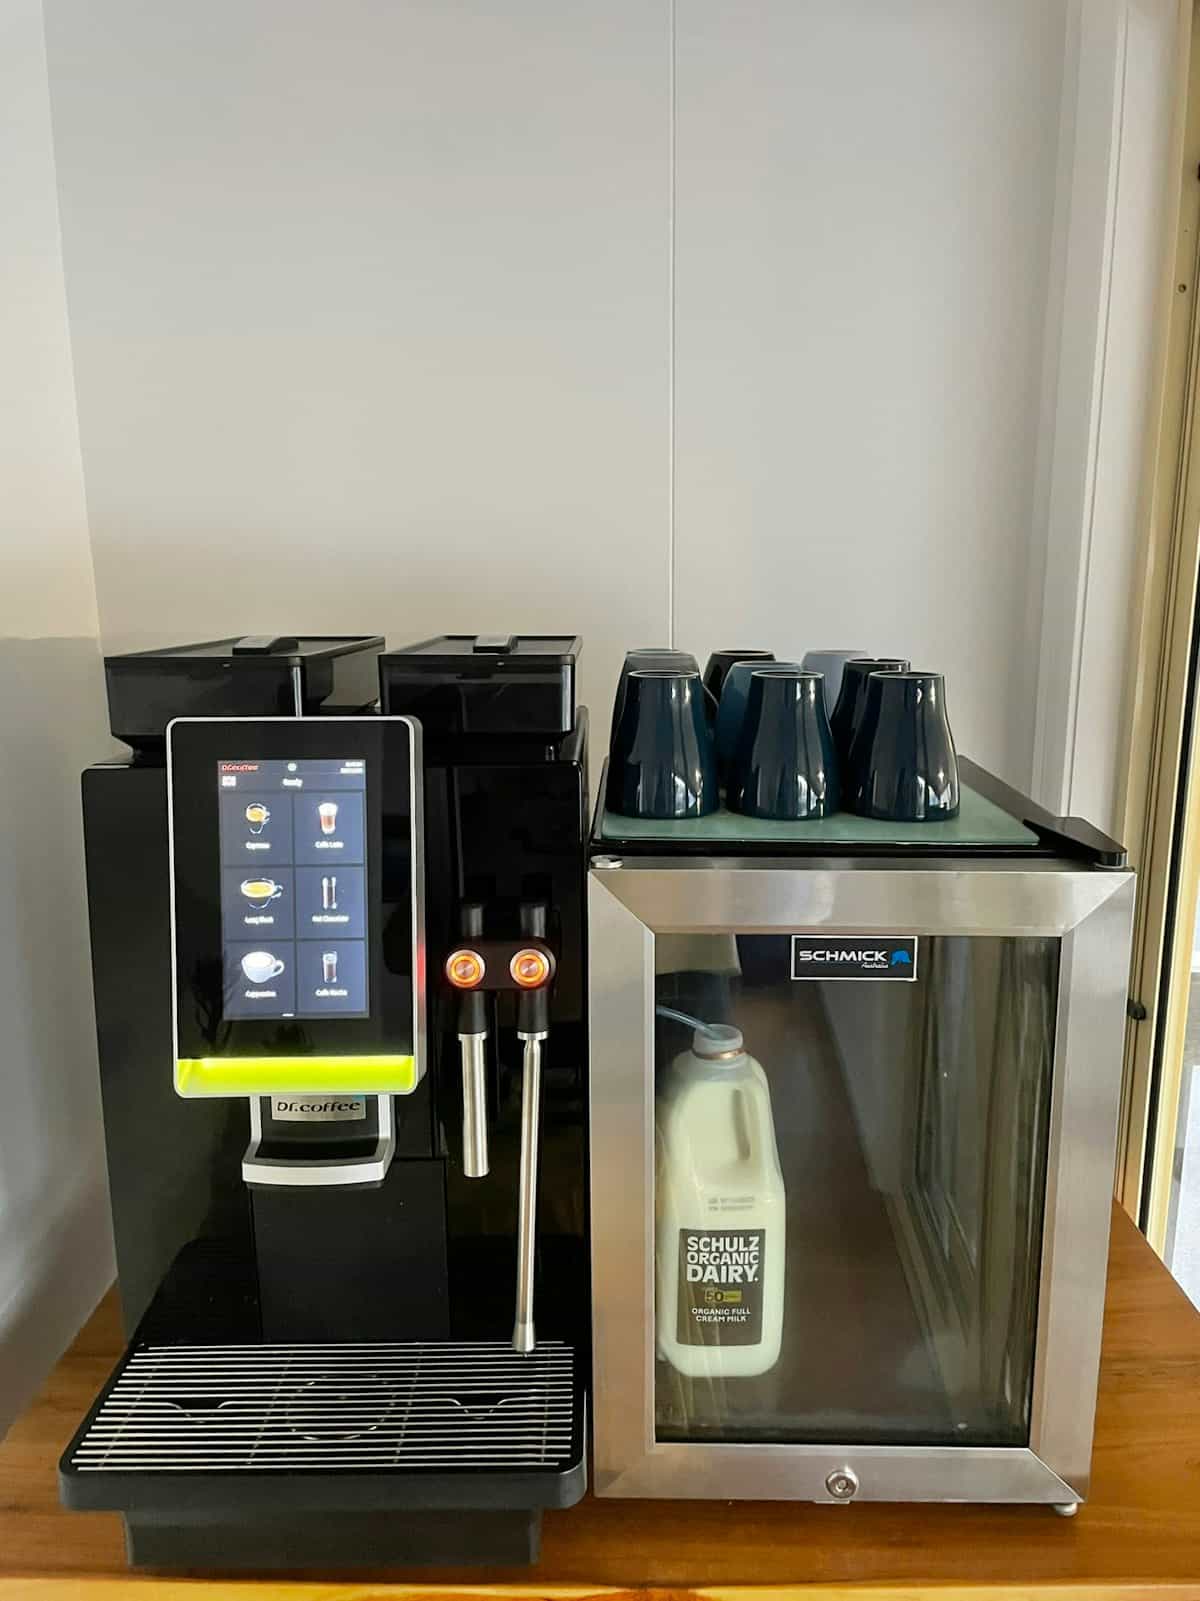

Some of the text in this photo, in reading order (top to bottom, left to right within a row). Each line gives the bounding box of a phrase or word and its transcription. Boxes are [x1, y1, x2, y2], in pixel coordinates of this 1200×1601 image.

[799, 949, 888, 962] SCHMICK
[277, 1101, 360, 1112] Dr.coffee
[687, 1236, 759, 1252] SCHULZ
[687, 1251, 759, 1265] ORGANIC
[691, 1307, 751, 1315] ORGANIC FULL
